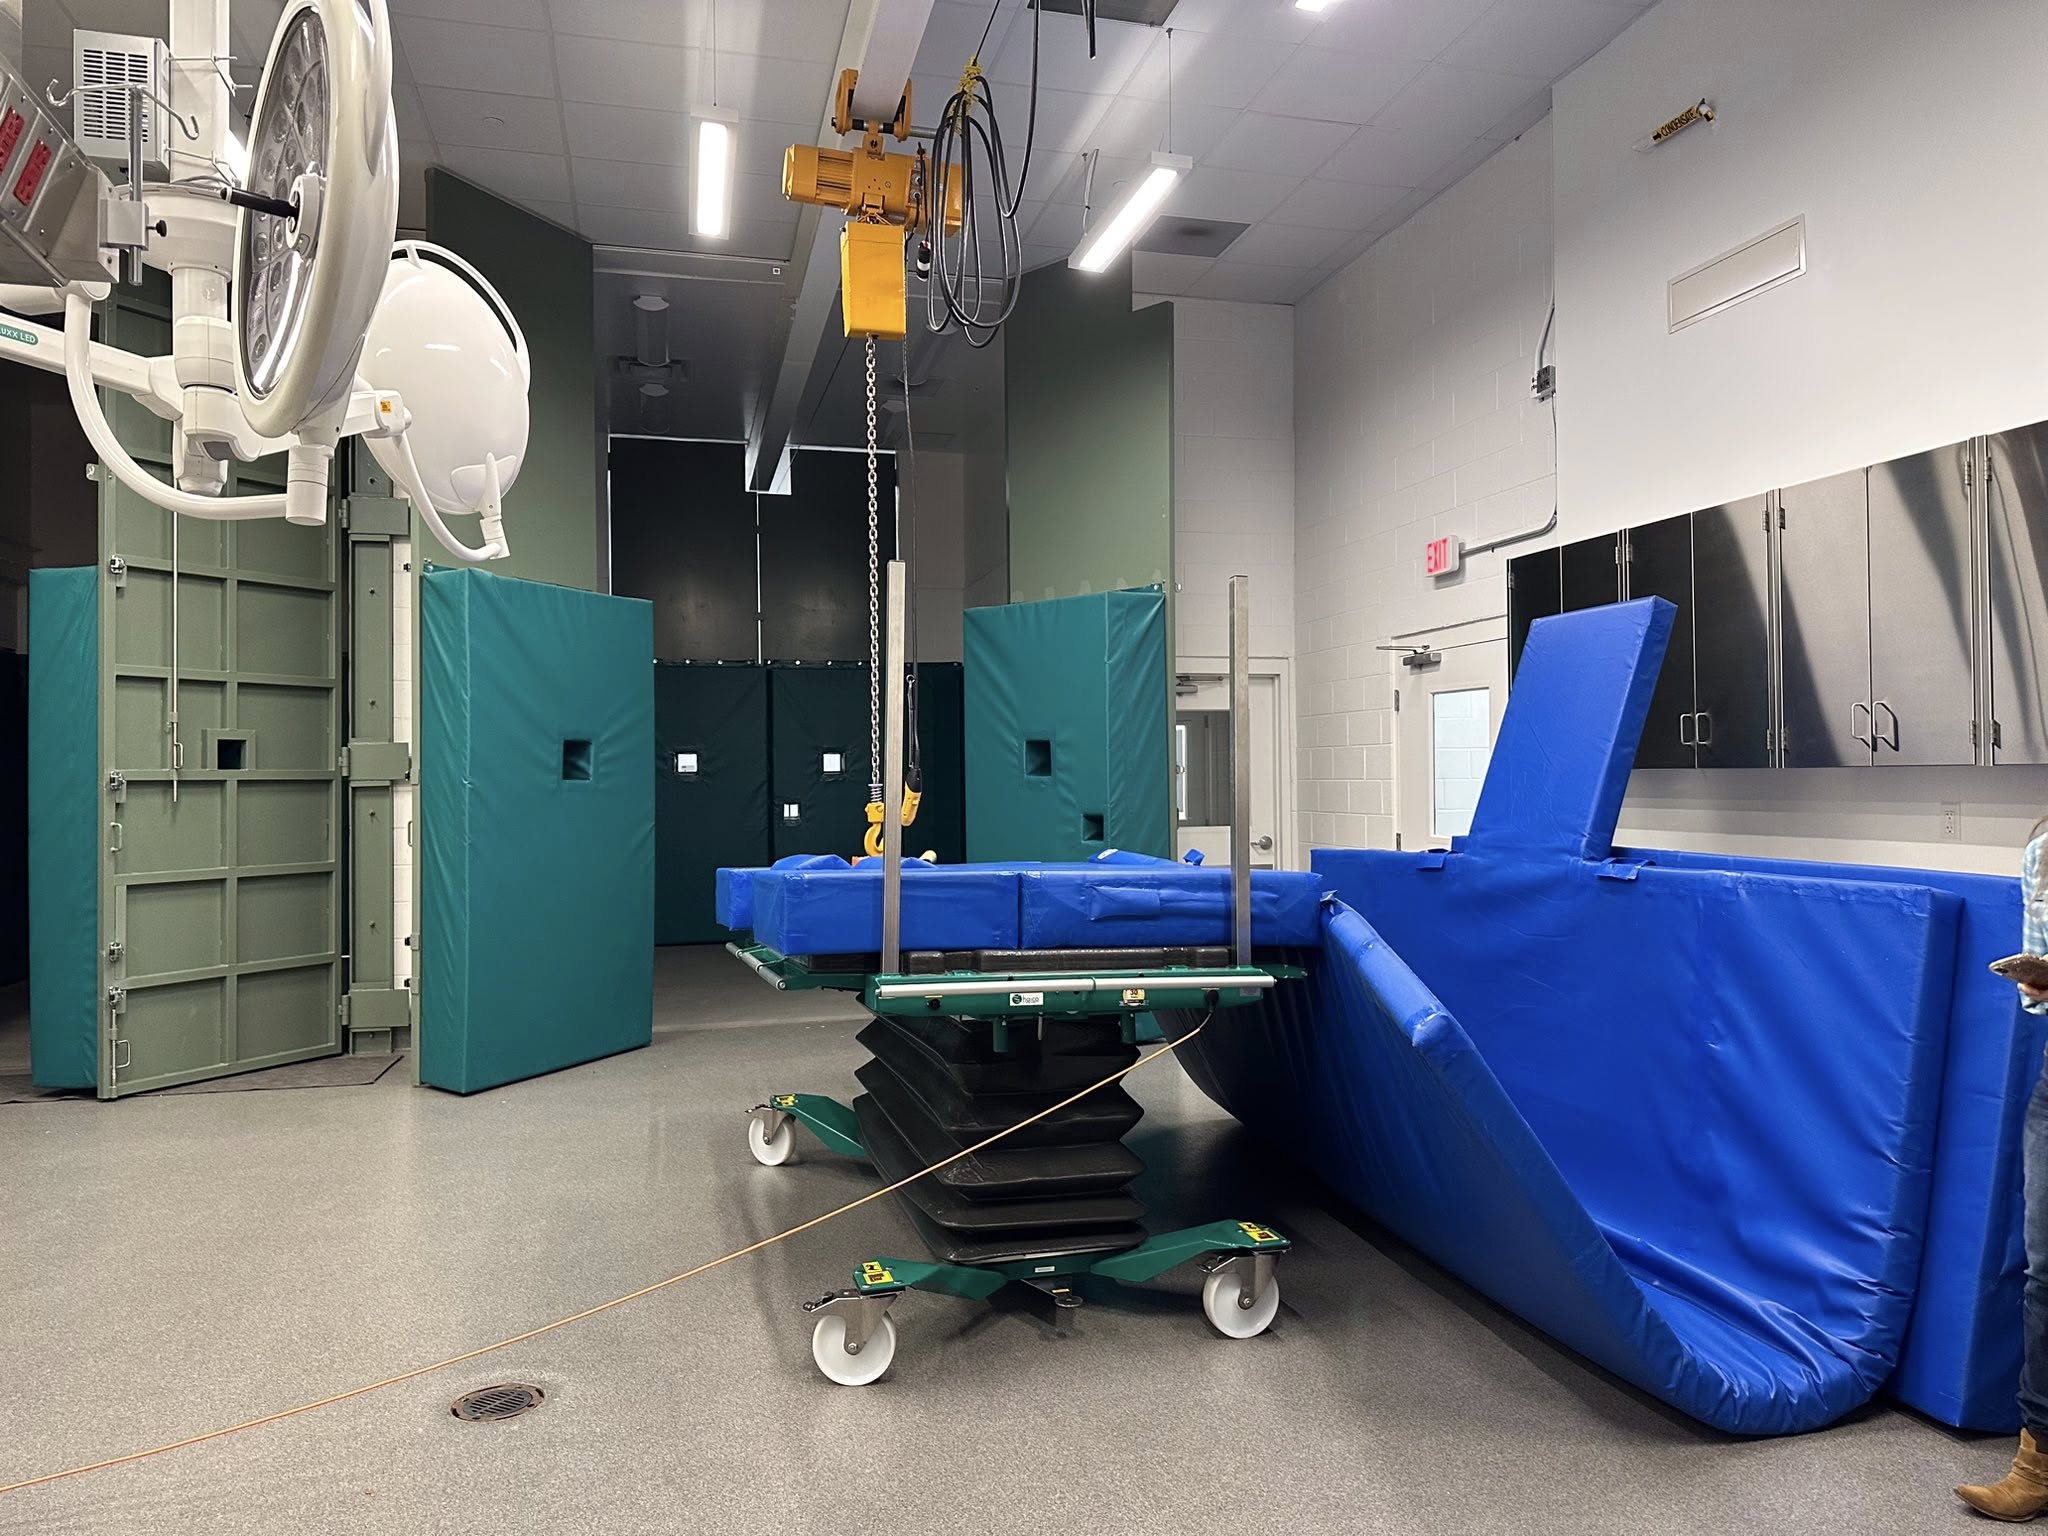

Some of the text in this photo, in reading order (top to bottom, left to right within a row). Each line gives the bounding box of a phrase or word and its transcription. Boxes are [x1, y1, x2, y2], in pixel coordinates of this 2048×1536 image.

[1661, 107, 1697, 136] CONDENSATE
[0, 327, 36, 343] UXX LED
[1426, 538, 1448, 573] EXIT
